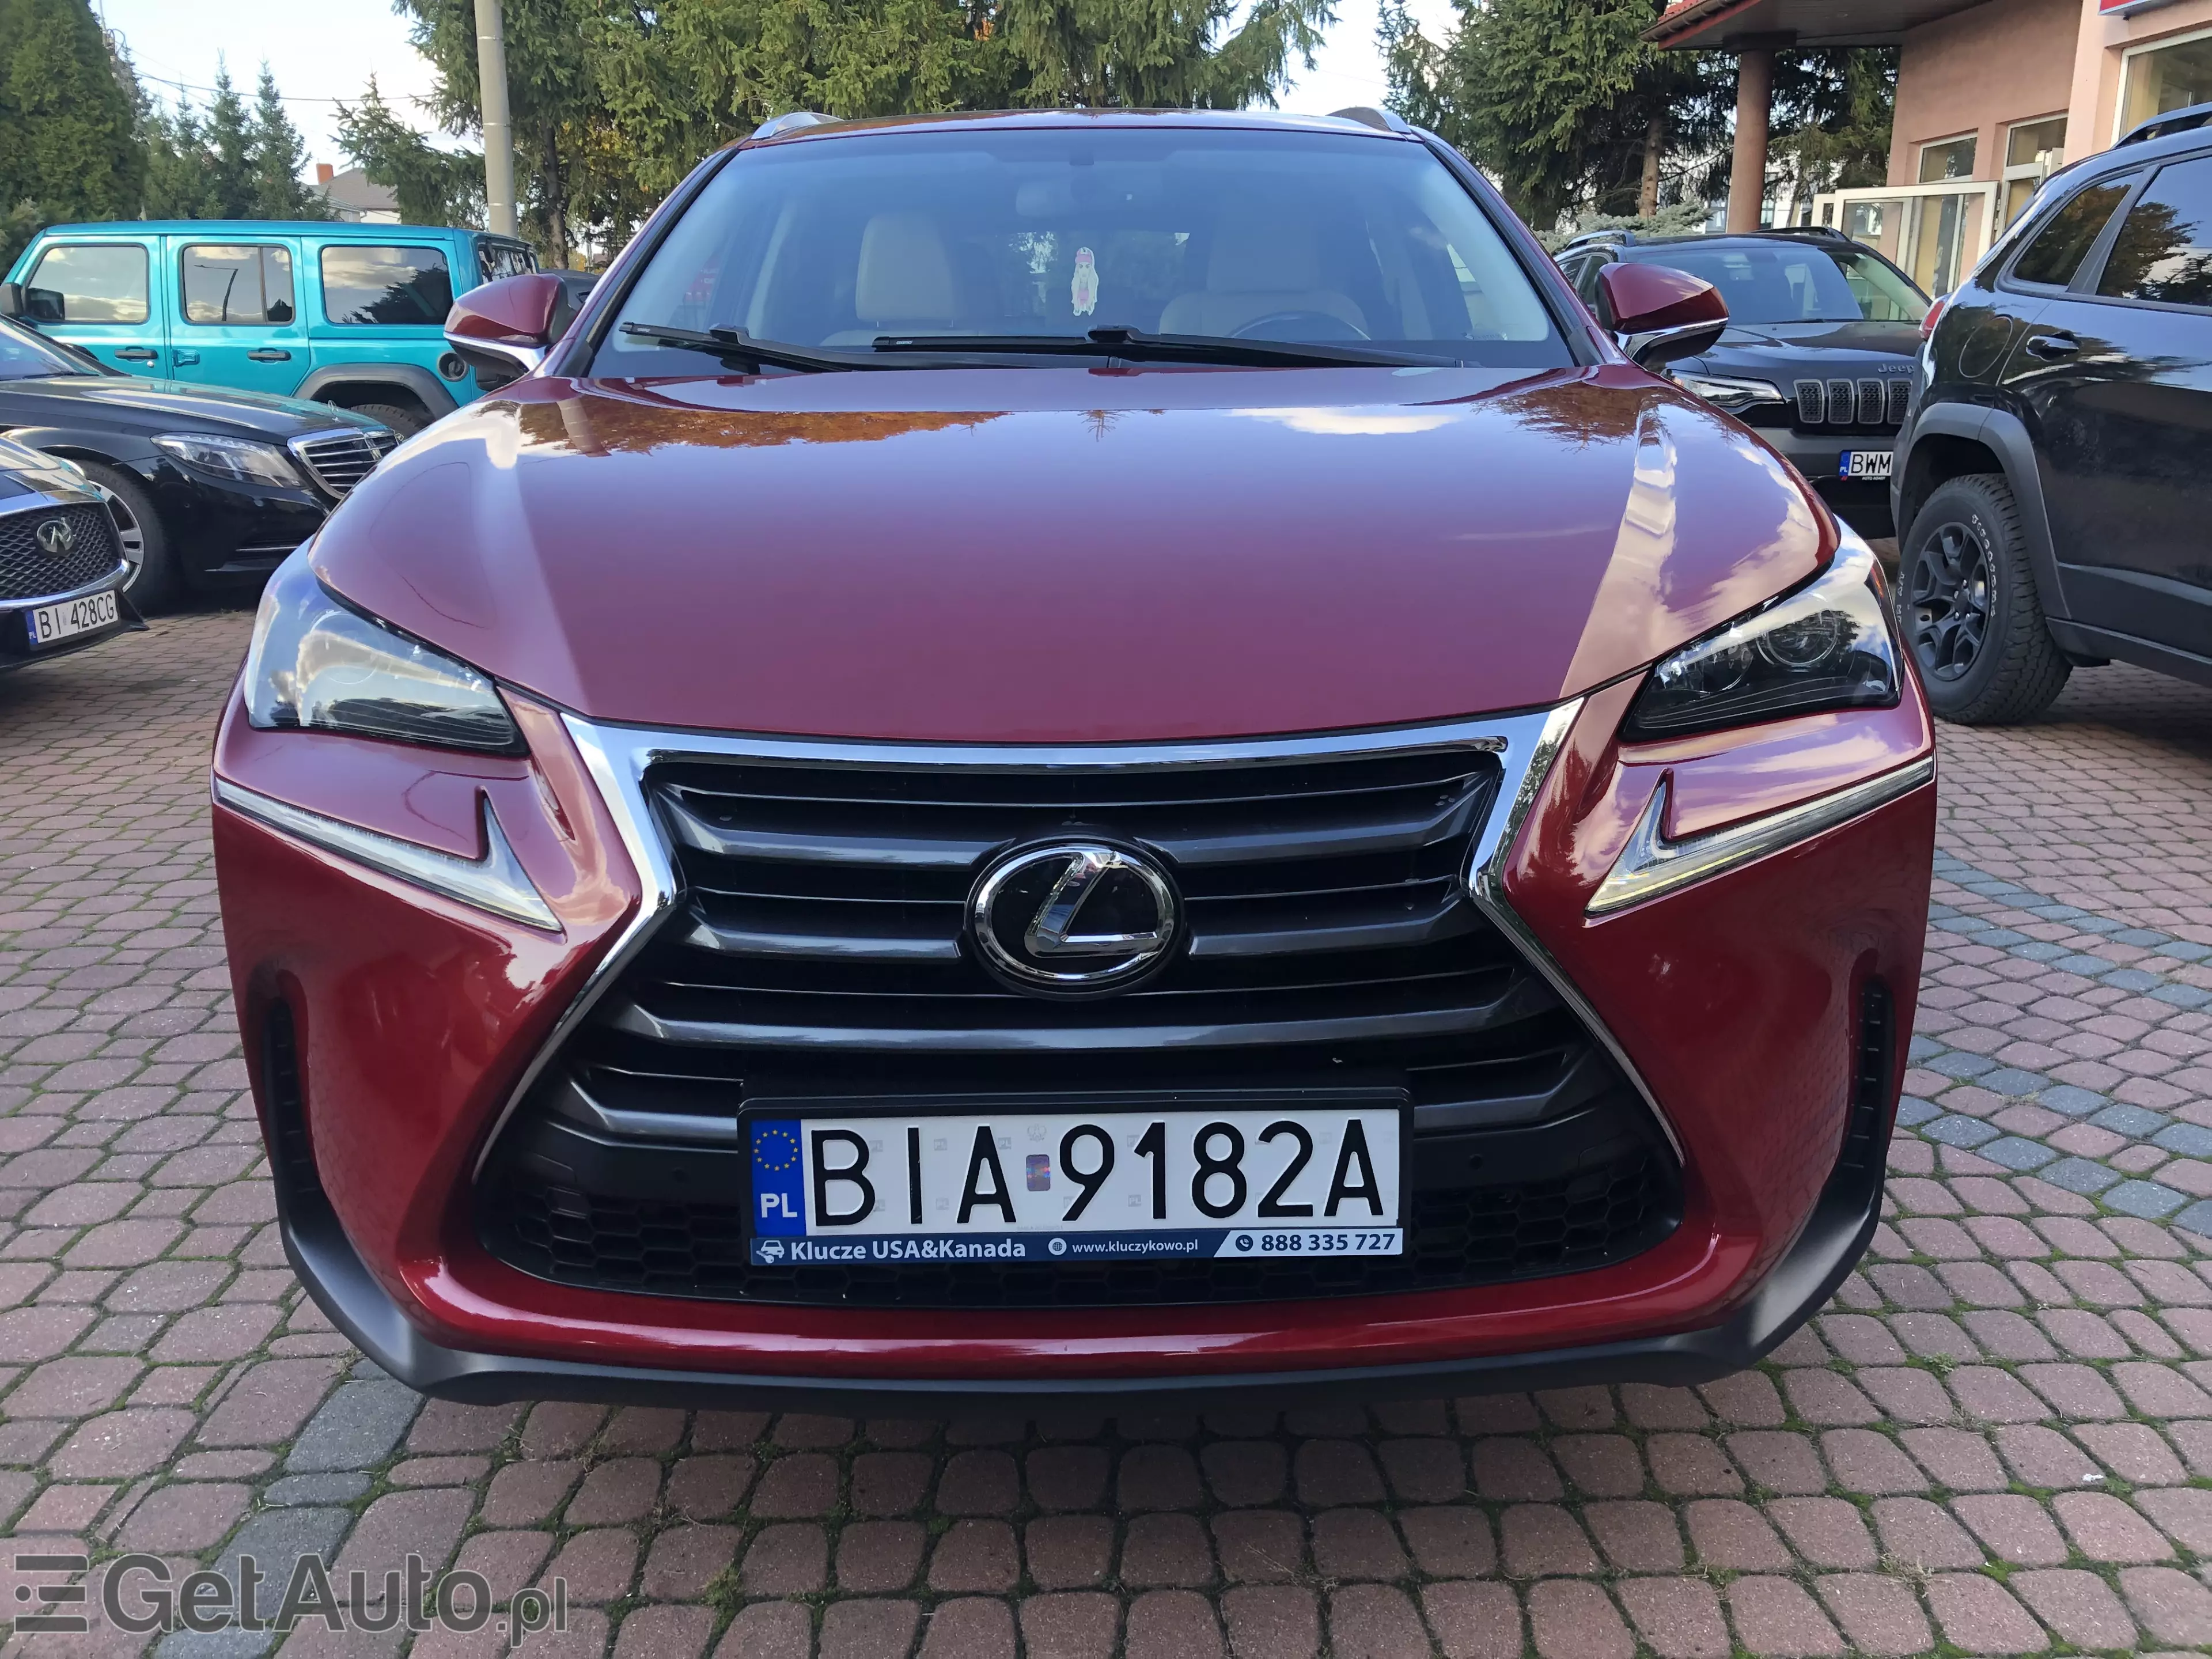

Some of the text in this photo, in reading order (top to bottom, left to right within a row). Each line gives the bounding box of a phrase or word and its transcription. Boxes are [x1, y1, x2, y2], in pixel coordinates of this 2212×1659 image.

[1878, 363, 1914, 374] Jeep
[1851, 454, 1891, 474] BWM
[39, 594, 114, 639] BI 428CG
[810, 1119, 1384, 1227] BIA 9182A
[760, 1193, 798, 1218] PL
[791, 1238, 1026, 1260] Klucze USA&Kanada
[1072, 1238, 1199, 1254] www.kluczykowo.pl
[1261, 1233, 1396, 1252] 888 335 727
